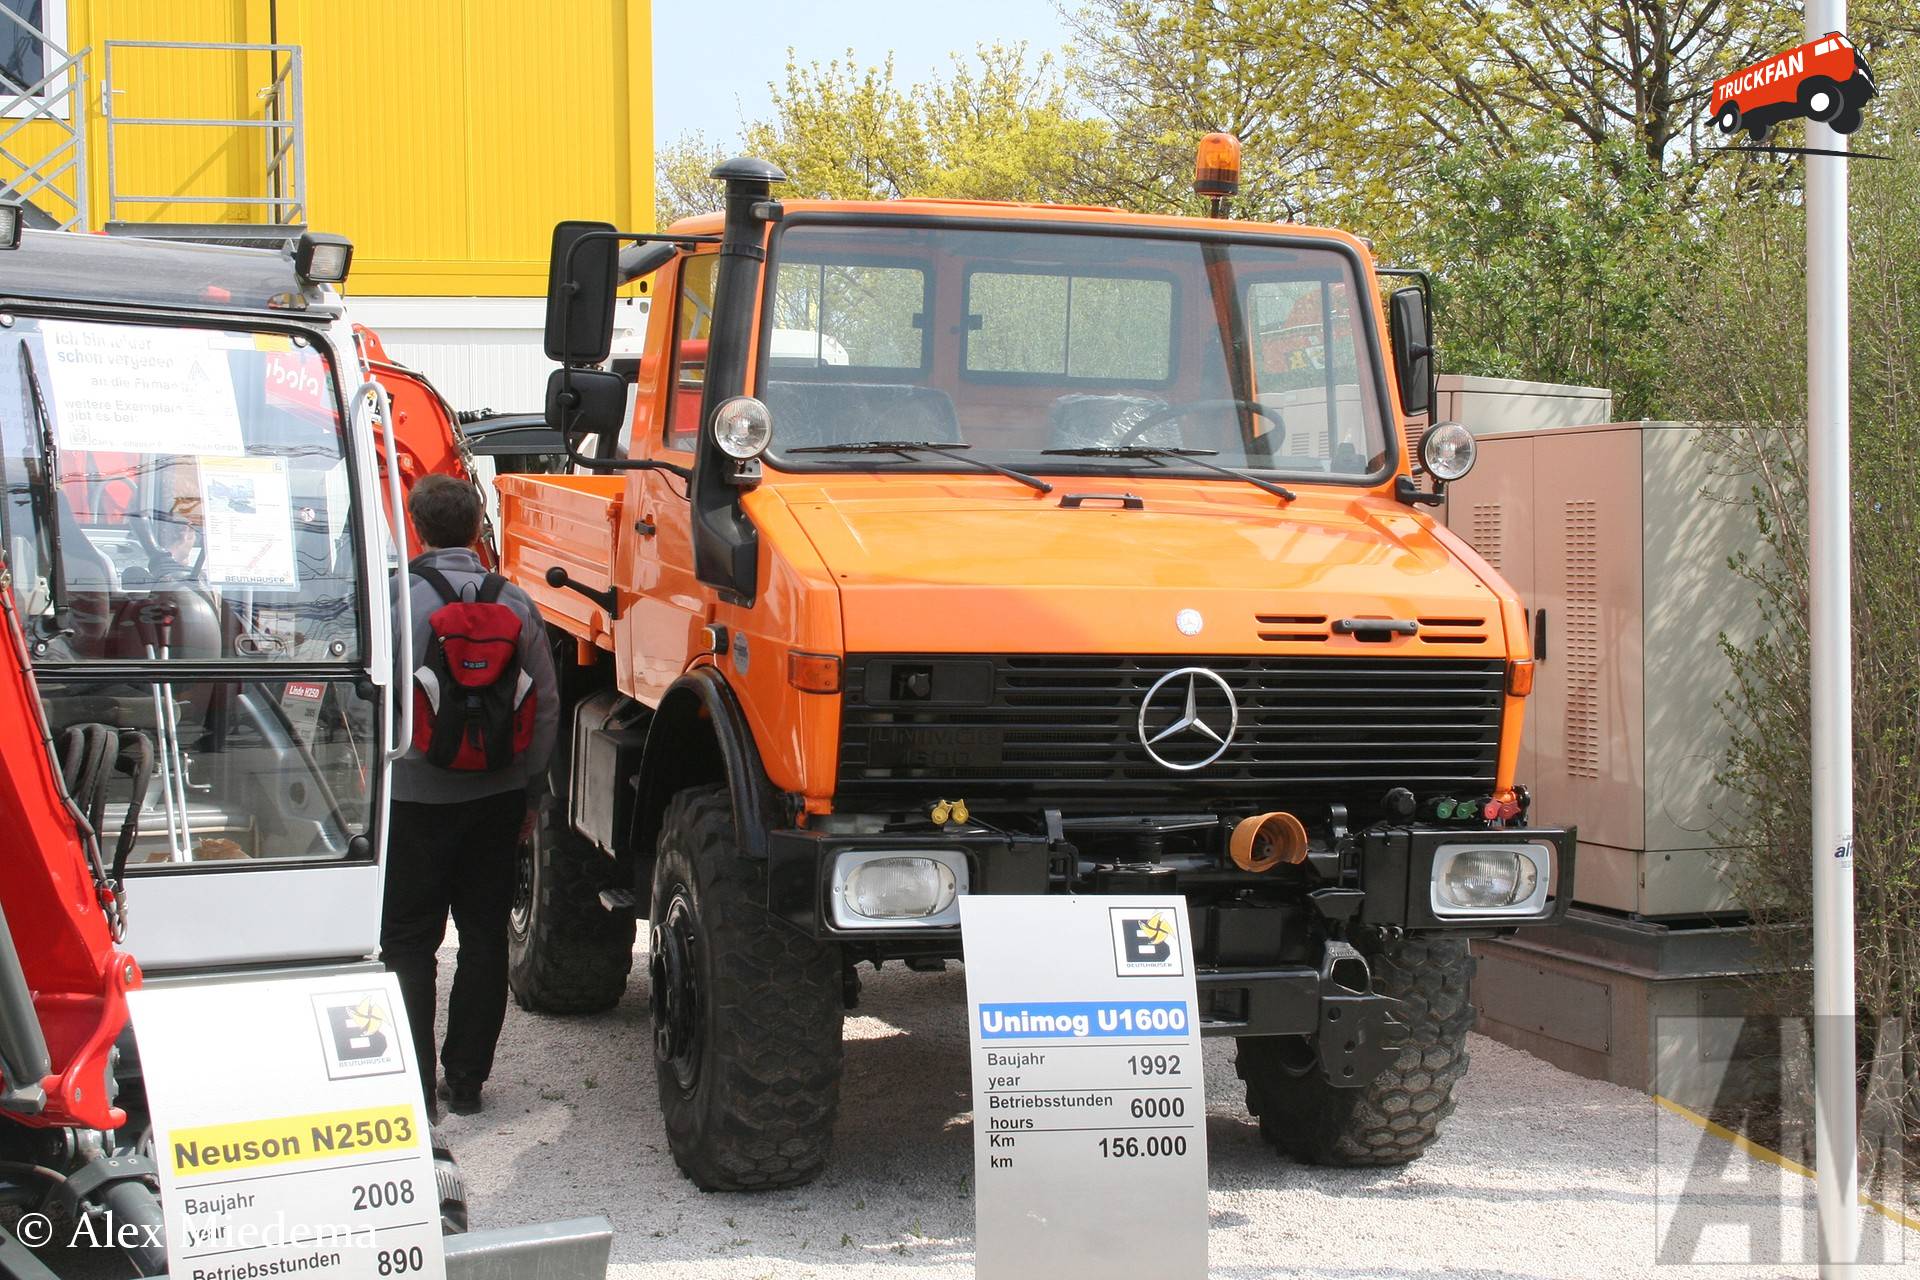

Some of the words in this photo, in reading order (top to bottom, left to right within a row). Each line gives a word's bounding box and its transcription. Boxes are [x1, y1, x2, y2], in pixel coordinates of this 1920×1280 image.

[57, 349, 103, 366] schon
[982, 1011, 1089, 1036] Unimog
[1098, 1008, 1185, 1031] U1600
[987, 1053, 1046, 1068] Baujahr
[1127, 1055, 1181, 1076] 1992
[988, 1075, 1021, 1090] year
[989, 1094, 1113, 1110] Betriebsstunden
[1130, 1098, 1185, 1119] 6000
[990, 1116, 1034, 1130] hours
[174, 1134, 300, 1169] Neuson
[310, 1116, 412, 1152] N2503
[990, 1134, 1015, 1148] Km
[1098, 1136, 1187, 1158] 156.000
[990, 1155, 1013, 1169] km
[184, 1192, 255, 1216] Baujahr
[351, 1179, 415, 1211] 2008
[193, 1251, 341, 1280] Betriebsstunden
[377, 1246, 424, 1276] 890
